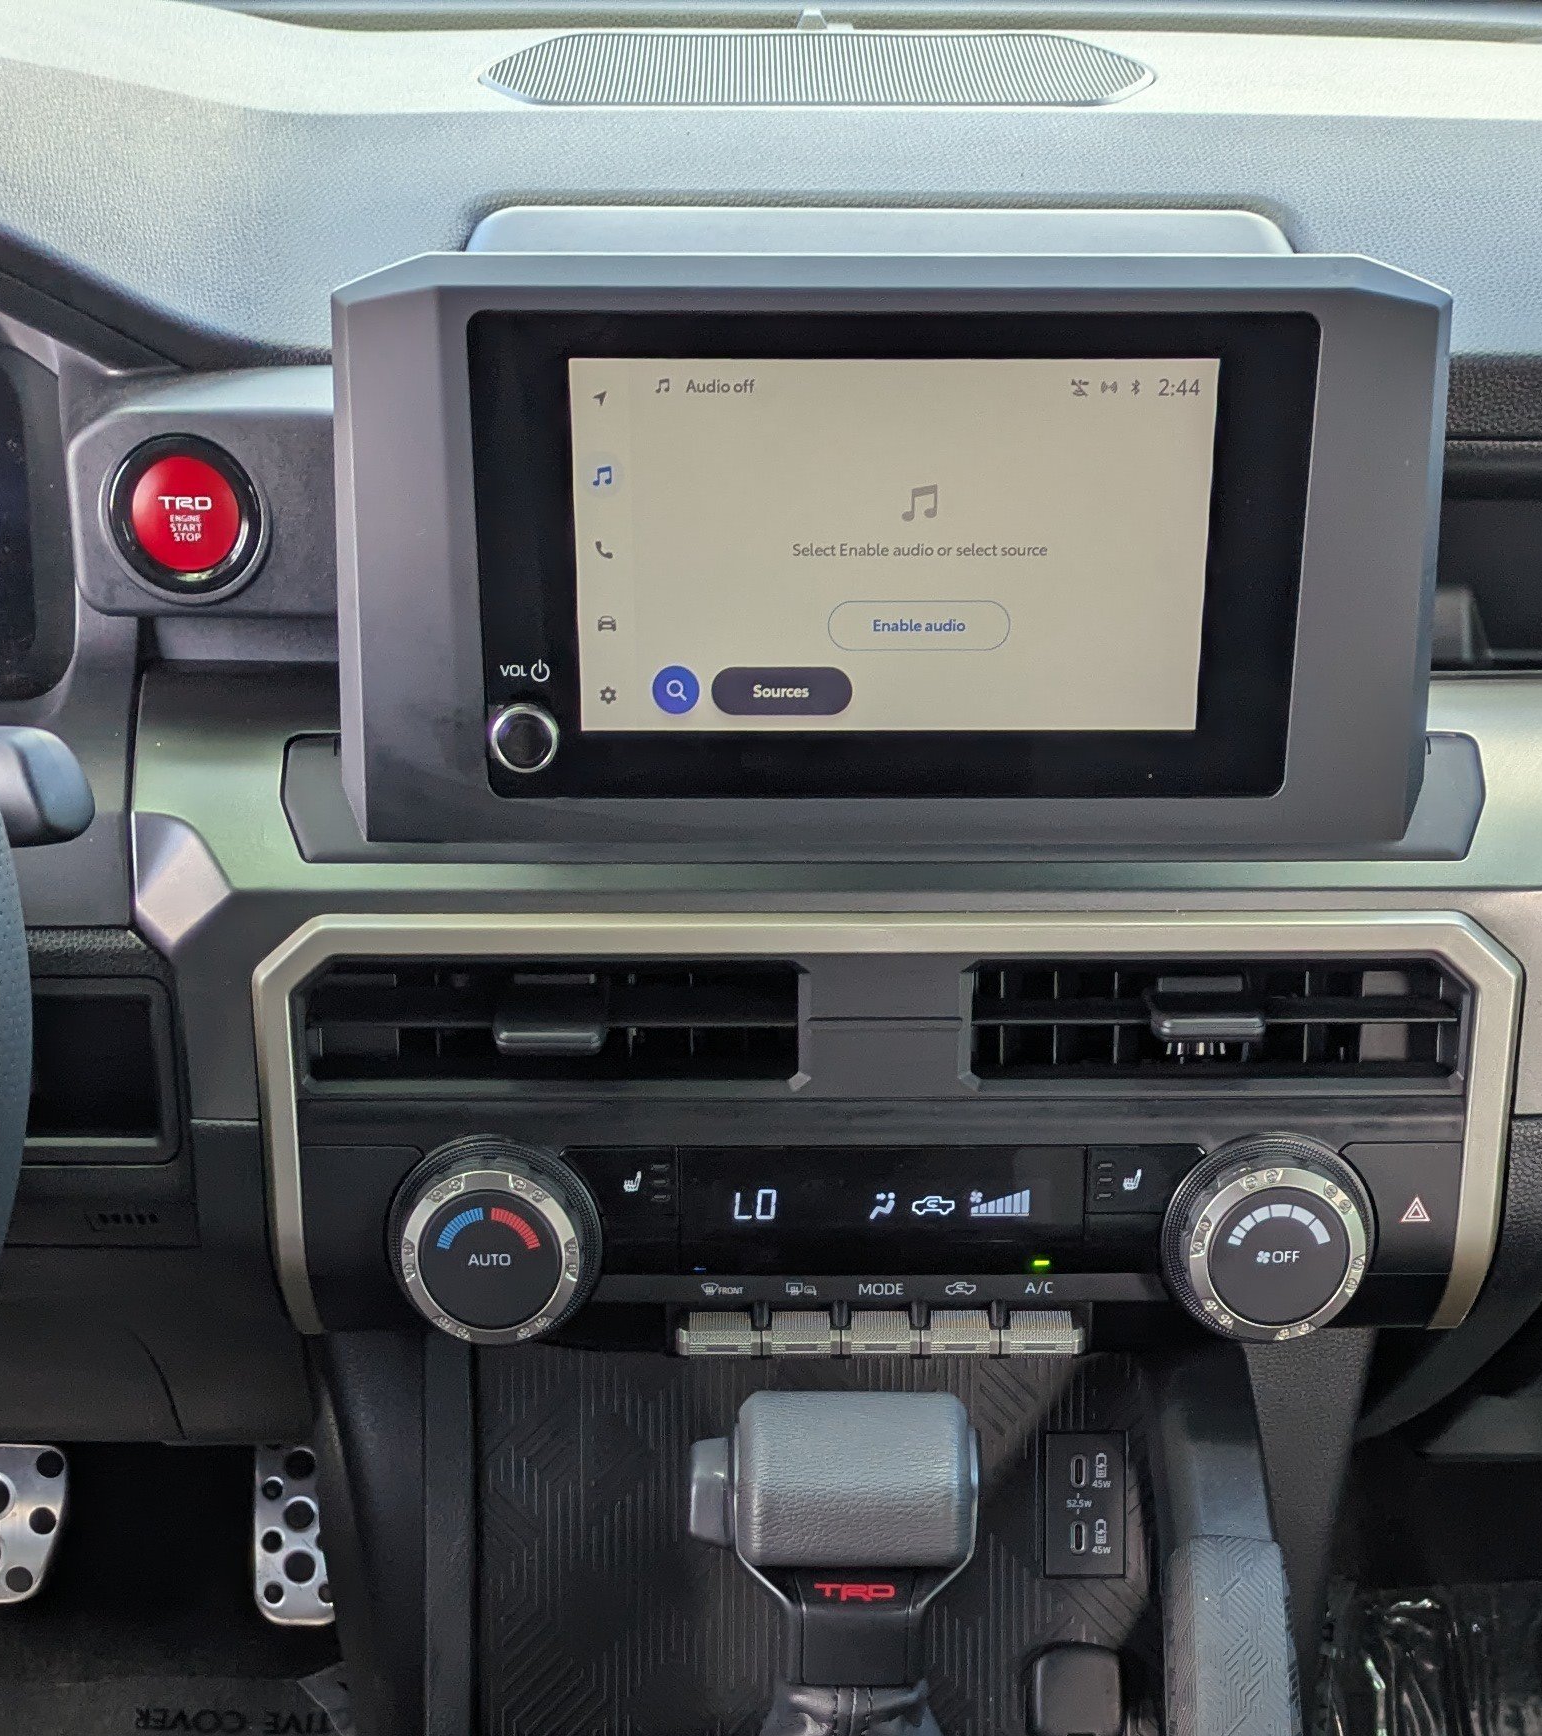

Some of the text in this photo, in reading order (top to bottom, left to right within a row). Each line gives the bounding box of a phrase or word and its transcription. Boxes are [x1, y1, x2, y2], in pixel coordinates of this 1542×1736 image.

[685, 377, 756, 393] Audio off
[1157, 377, 1201, 398] 2:44
[157, 496, 212, 510] TRD
[169, 514, 201, 523] ENGINE
[170, 523, 202, 532] START
[173, 532, 202, 542] STOP
[792, 543, 1048, 557] Select Enable audio or select source
[872, 619, 966, 632] Enable audio
[500, 664, 527, 678] VOL
[752, 684, 809, 699] Sources
[733, 1189, 777, 1220] LO
[468, 1253, 512, 1266] AUTO
[1272, 1250, 1300, 1263] OFF
[718, 1286, 744, 1295] FRONT
[858, 1283, 904, 1296] MODE
[1024, 1281, 1054, 1294] A/C
[1092, 1480, 1111, 1488] 45W
[1092, 1545, 1111, 1554] 45W
[814, 1583, 895, 1601] TRD
